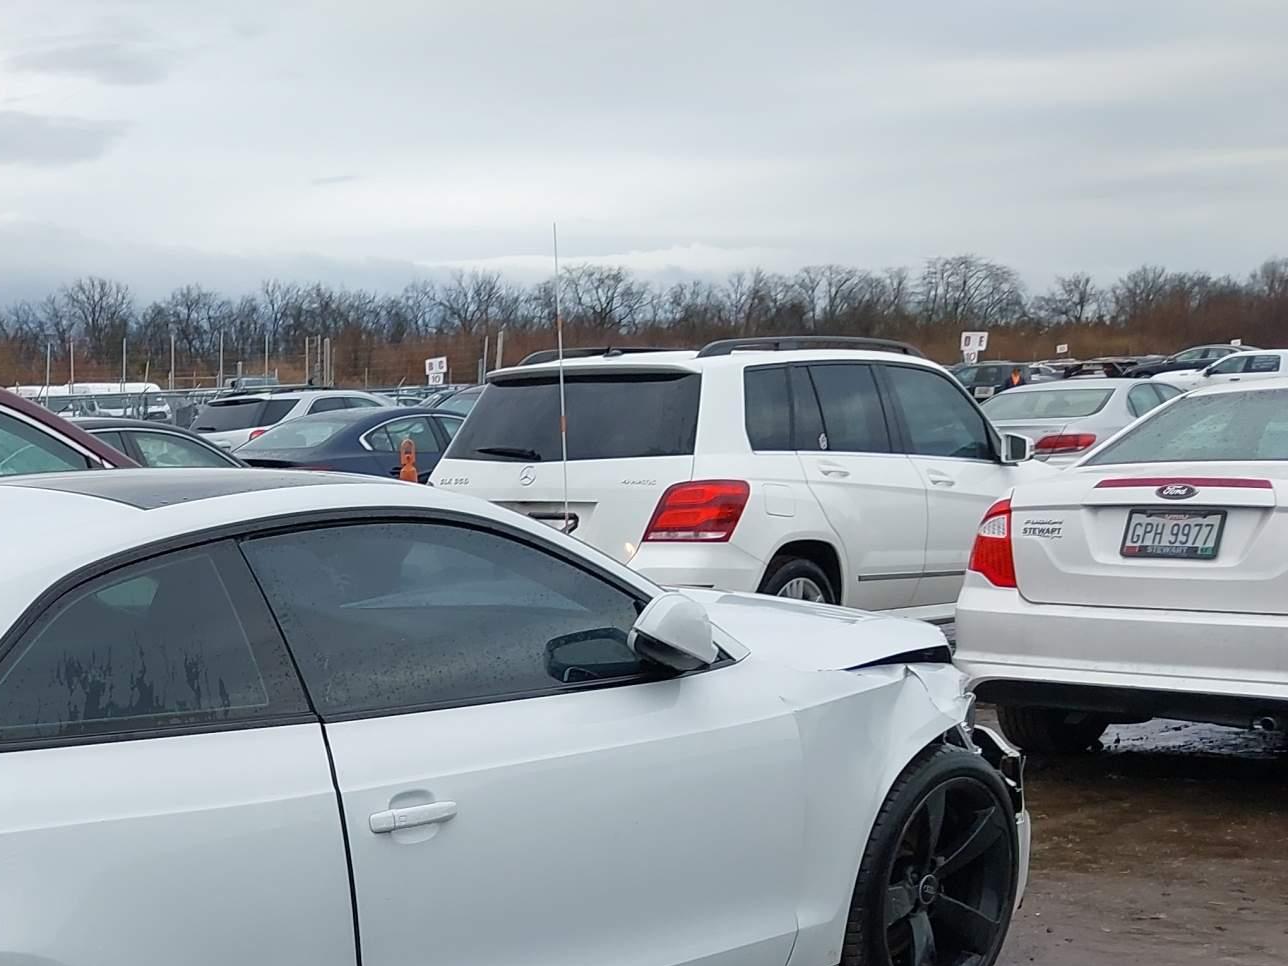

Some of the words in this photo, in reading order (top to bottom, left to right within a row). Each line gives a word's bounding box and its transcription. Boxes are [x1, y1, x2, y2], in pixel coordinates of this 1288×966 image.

[1162, 485, 1188, 495] Ford
[1022, 527, 1061, 536] STEWART
[1130, 522, 1165, 545] GPH
[1168, 523, 1214, 546] 9977
